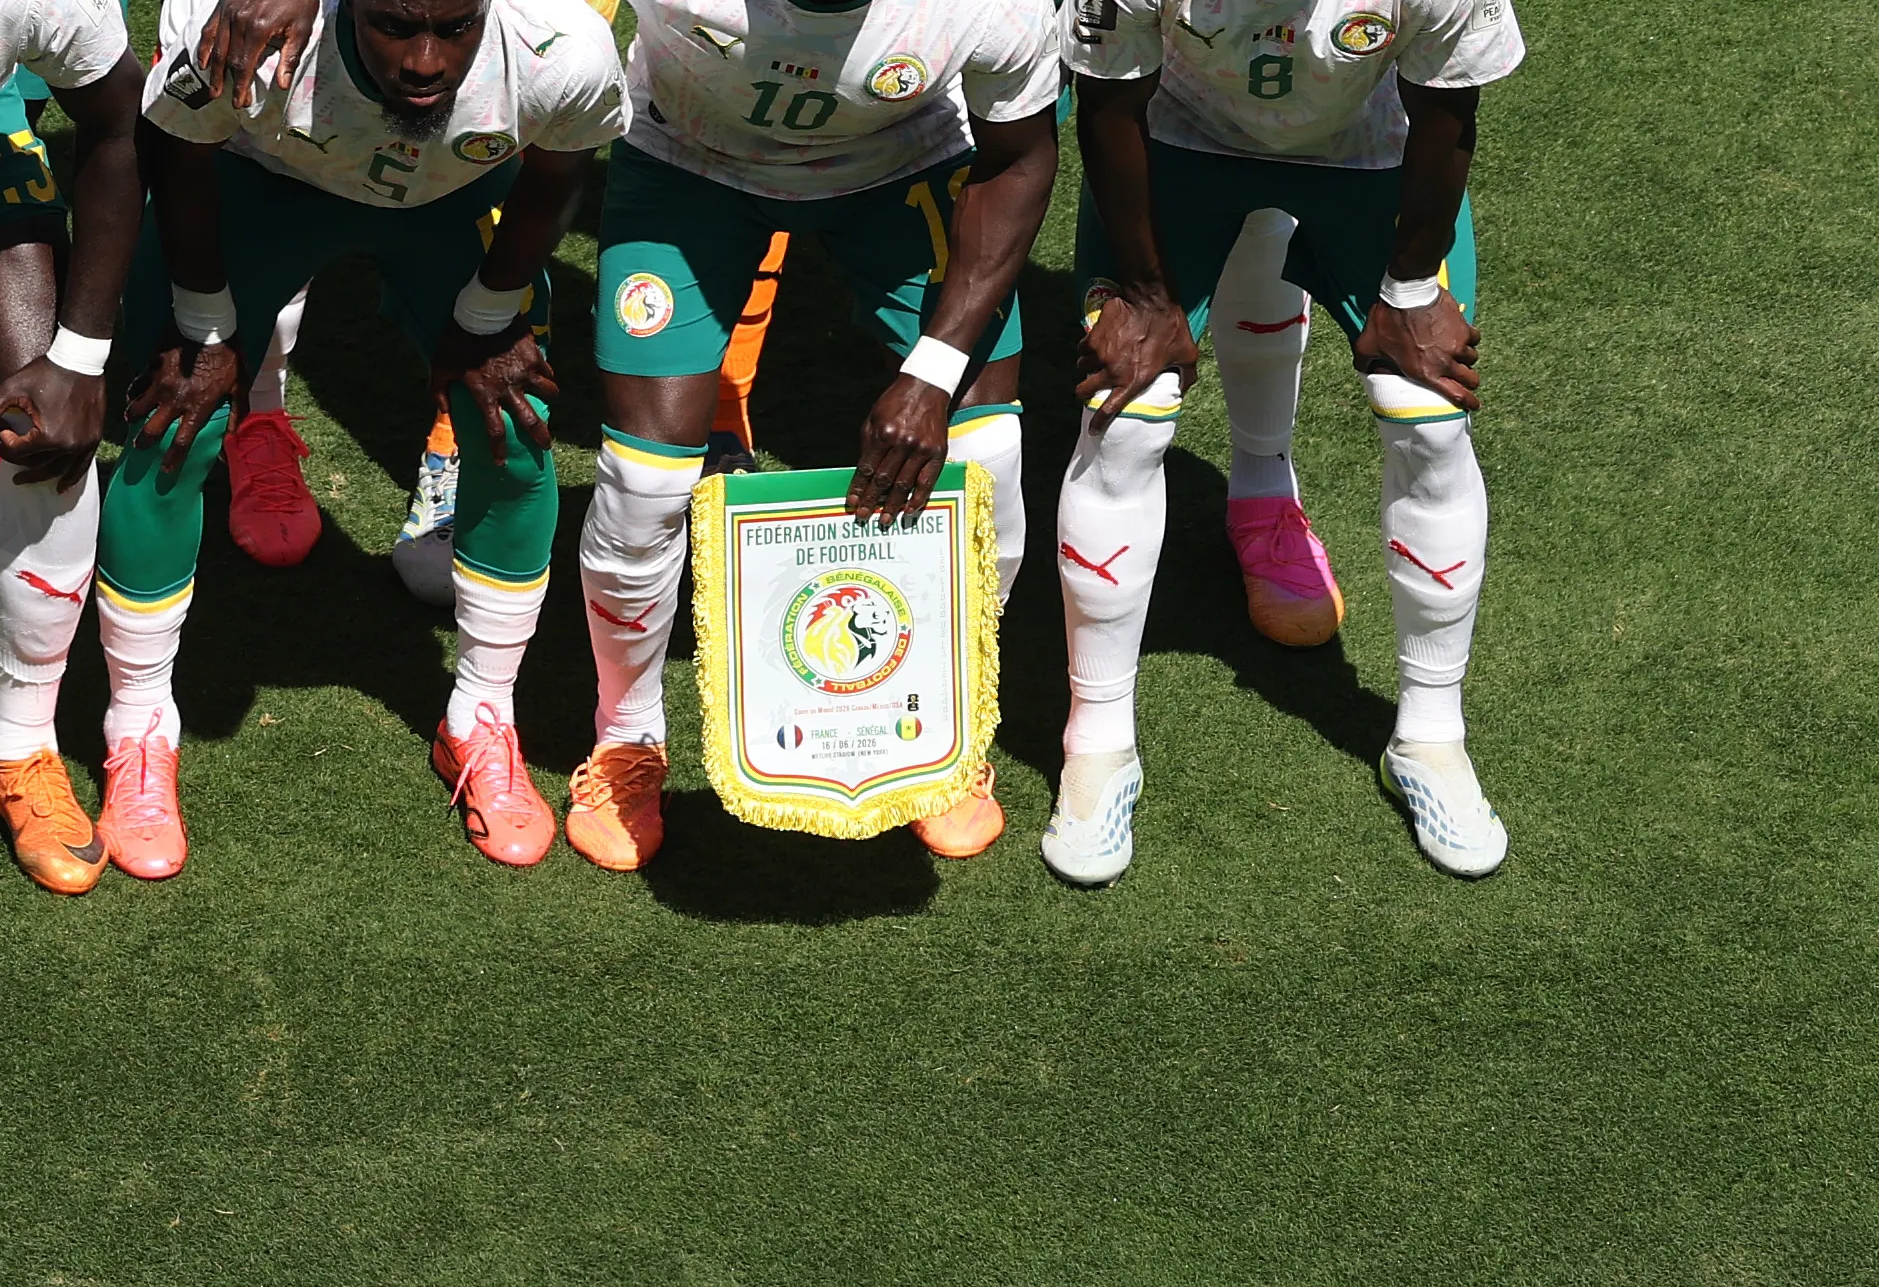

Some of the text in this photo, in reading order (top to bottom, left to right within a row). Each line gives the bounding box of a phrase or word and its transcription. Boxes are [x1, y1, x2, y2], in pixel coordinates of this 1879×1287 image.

[1248, 54, 1293, 100] 8
[741, 79, 839, 130] 10
[362, 151, 419, 203] 5
[746, 523, 836, 546] FÉDÉRATION
[796, 541, 895, 566] DE FOOTBALL
[831, 658, 898, 692] FOOTBALL
[810, 728, 839, 739] FRANCE
[856, 724, 888, 736] SÉNÉGAL
[857, 738, 877, 748] 2026
